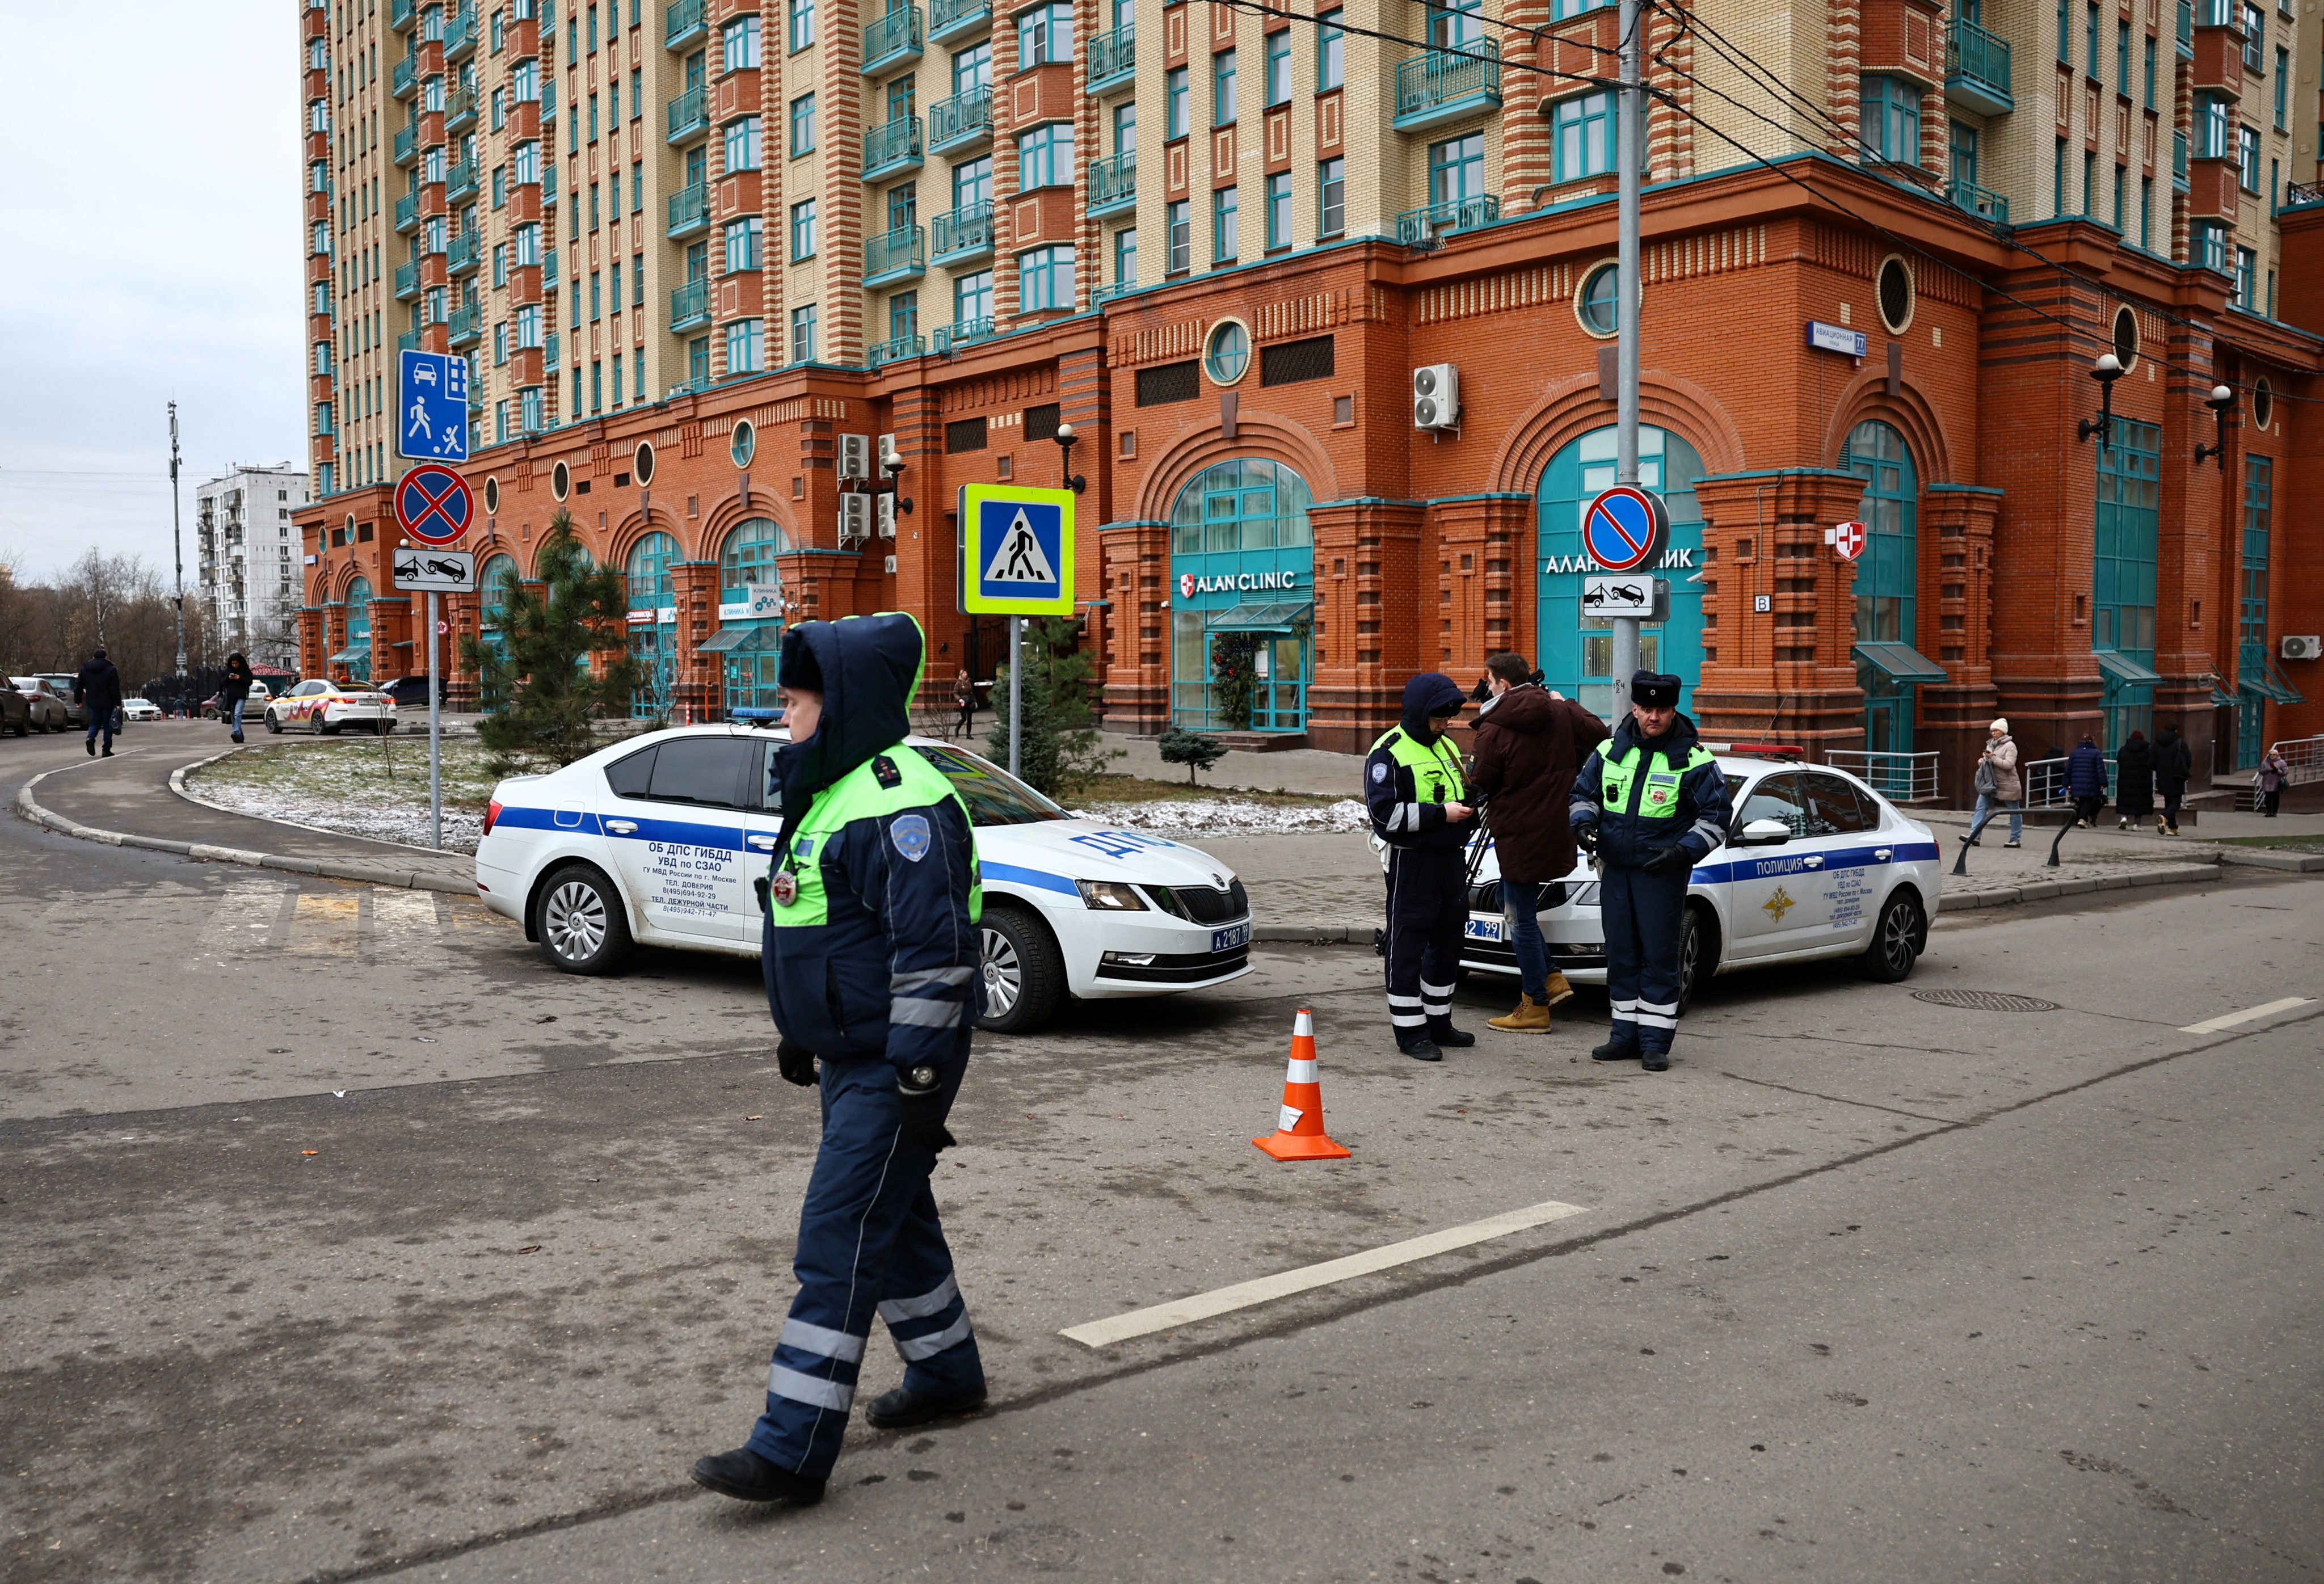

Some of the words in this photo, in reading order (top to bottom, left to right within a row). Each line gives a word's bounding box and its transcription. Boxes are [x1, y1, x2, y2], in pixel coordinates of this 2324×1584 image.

[1816, 327, 1853, 342] АВИАЦИОННАЯ
[1856, 337, 1864, 348] 77
[1196, 574, 1235, 592] ALAN
[1238, 571, 1295, 591] CLINIC
[1068, 831, 1176, 860] ДПС
[649, 842, 663, 853] ОБ
[667, 844, 691, 856] ДПС
[694, 847, 732, 863] ГИБДД
[658, 856, 677, 869] УВД
[696, 861, 722, 871] СЗАО
[1757, 857, 1803, 875] ПОЛИЦИЯ
[652, 868, 667, 877] МВД
[670, 870, 692, 878] России
[712, 875, 736, 883] Москве
[1841, 870, 1850, 879] ДПС
[1851, 868, 1865, 878] ГИБДД
[682, 881, 713, 891] ДОВЕРИЯ
[663, 887, 716, 899] 8(495)694-92-29
[1829, 891, 1838, 900] МВД
[663, 905, 717, 917] 8(495)942-71-47
[668, 898, 705, 908] ДЕЖУРНОЙ
[706, 903, 729, 911] ЧАСТИ
[1243, 924, 1248, 937] 99
[1484, 921, 1498, 934] 99
[1223, 928, 1240, 947] 2187
